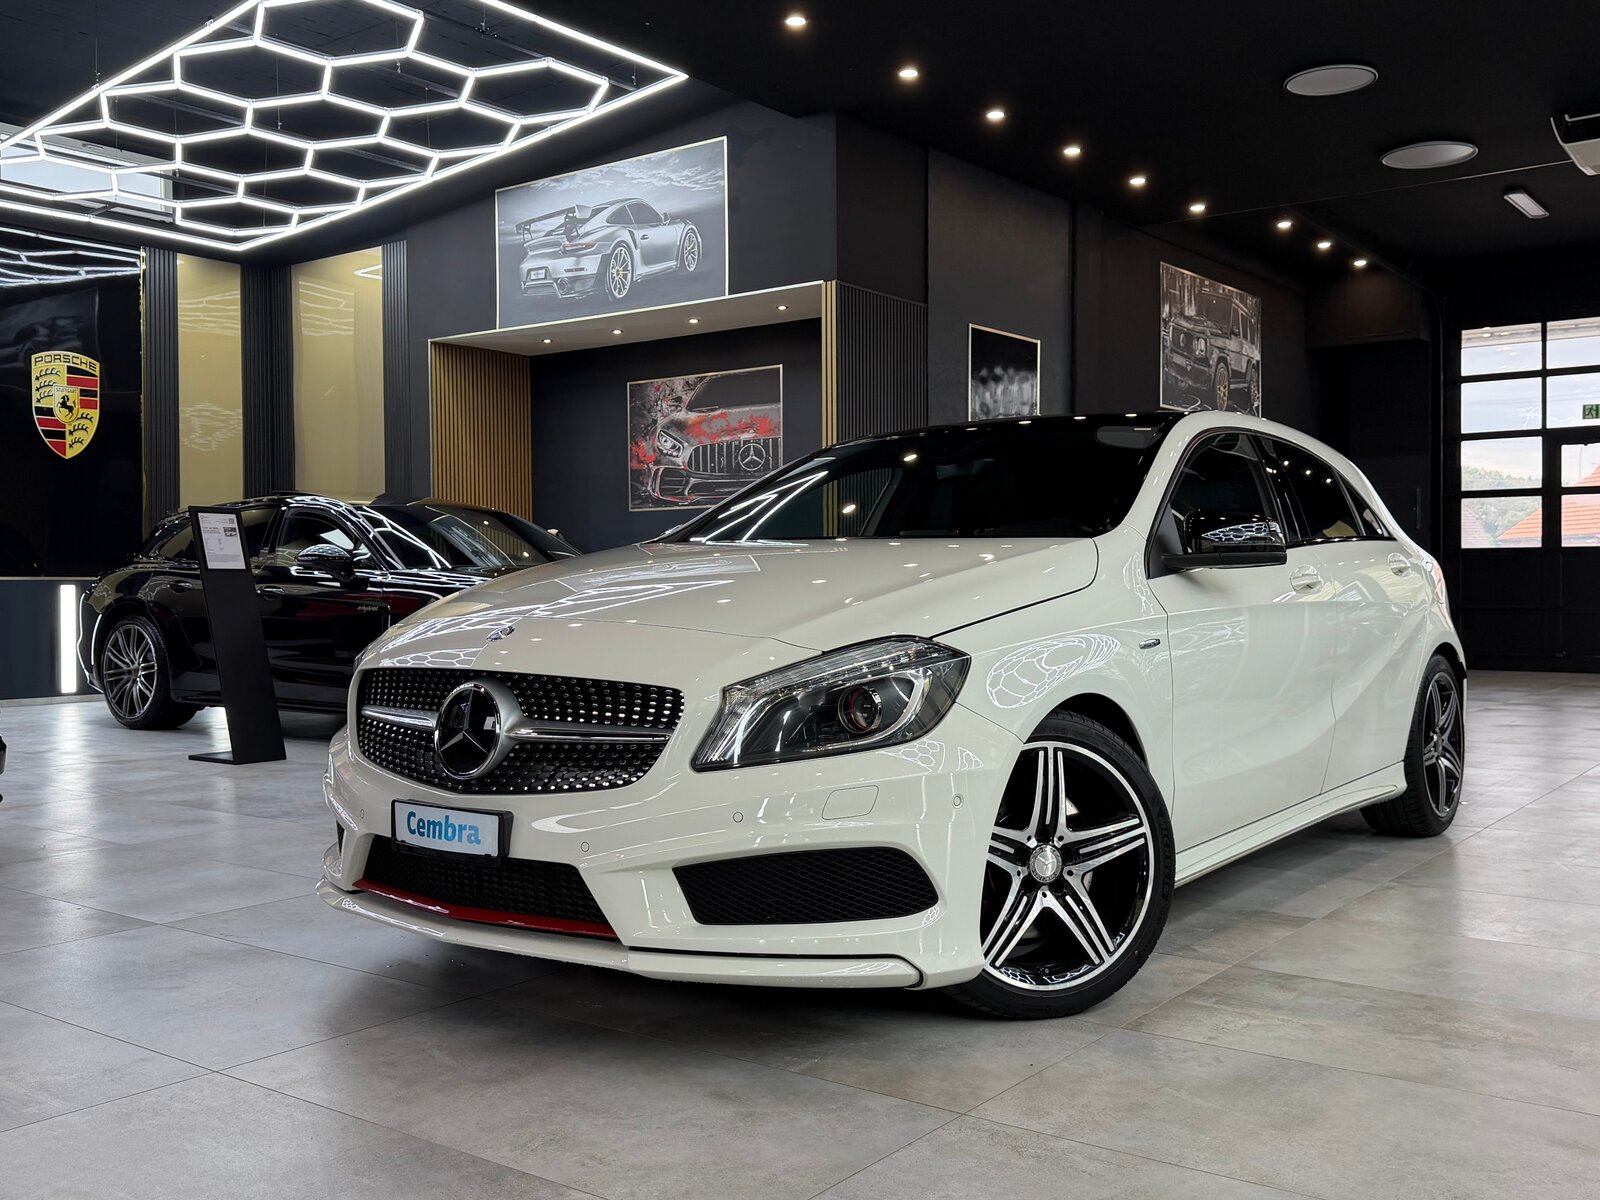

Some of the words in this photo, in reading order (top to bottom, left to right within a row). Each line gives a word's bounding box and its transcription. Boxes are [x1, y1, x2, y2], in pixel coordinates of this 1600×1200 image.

[34, 354, 97, 372] PORSCHE
[406, 811, 481, 845] Cembra
[1159, 816, 1171, 897] MICHELIN
